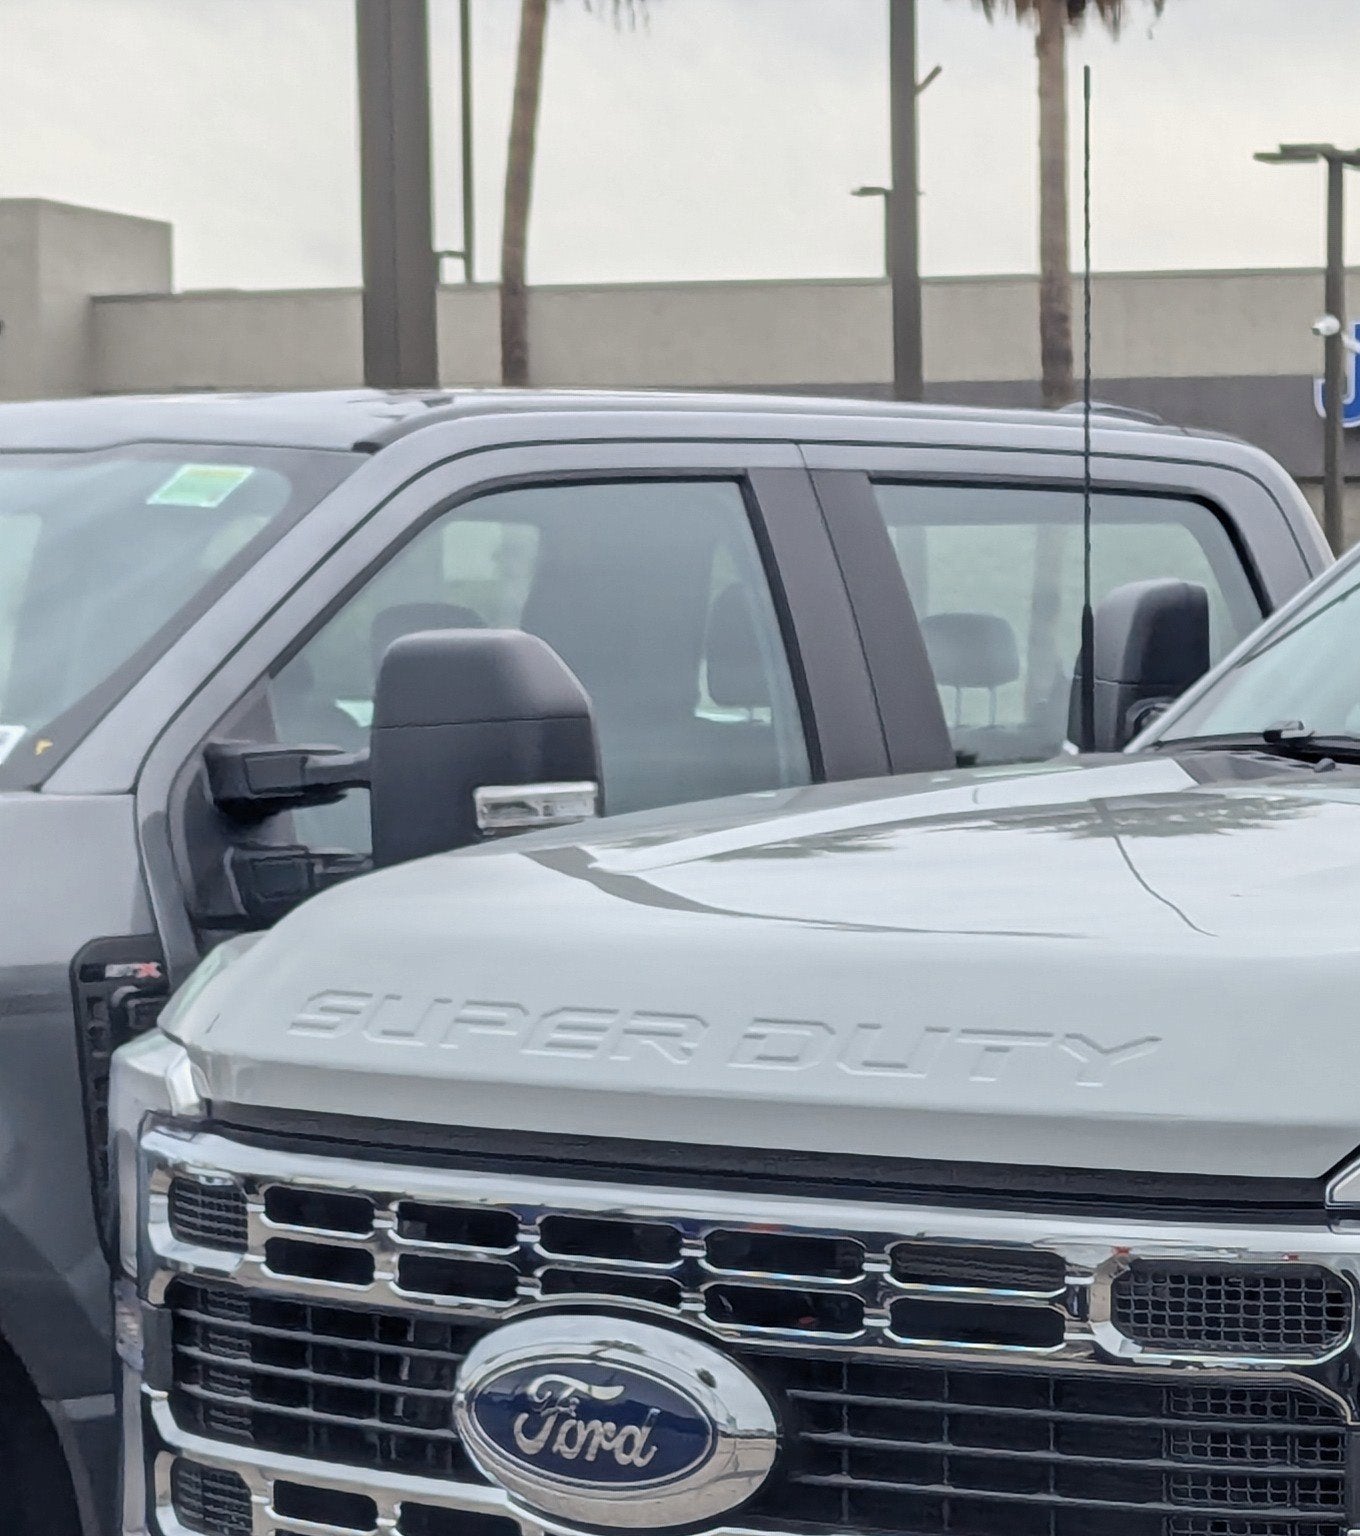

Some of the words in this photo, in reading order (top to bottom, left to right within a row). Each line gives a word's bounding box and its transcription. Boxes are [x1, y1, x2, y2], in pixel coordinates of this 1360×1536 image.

[287, 989, 711, 1065] SUPER
[726, 1016, 1162, 1087] DUTY
[513, 1373, 658, 1468] Ford
